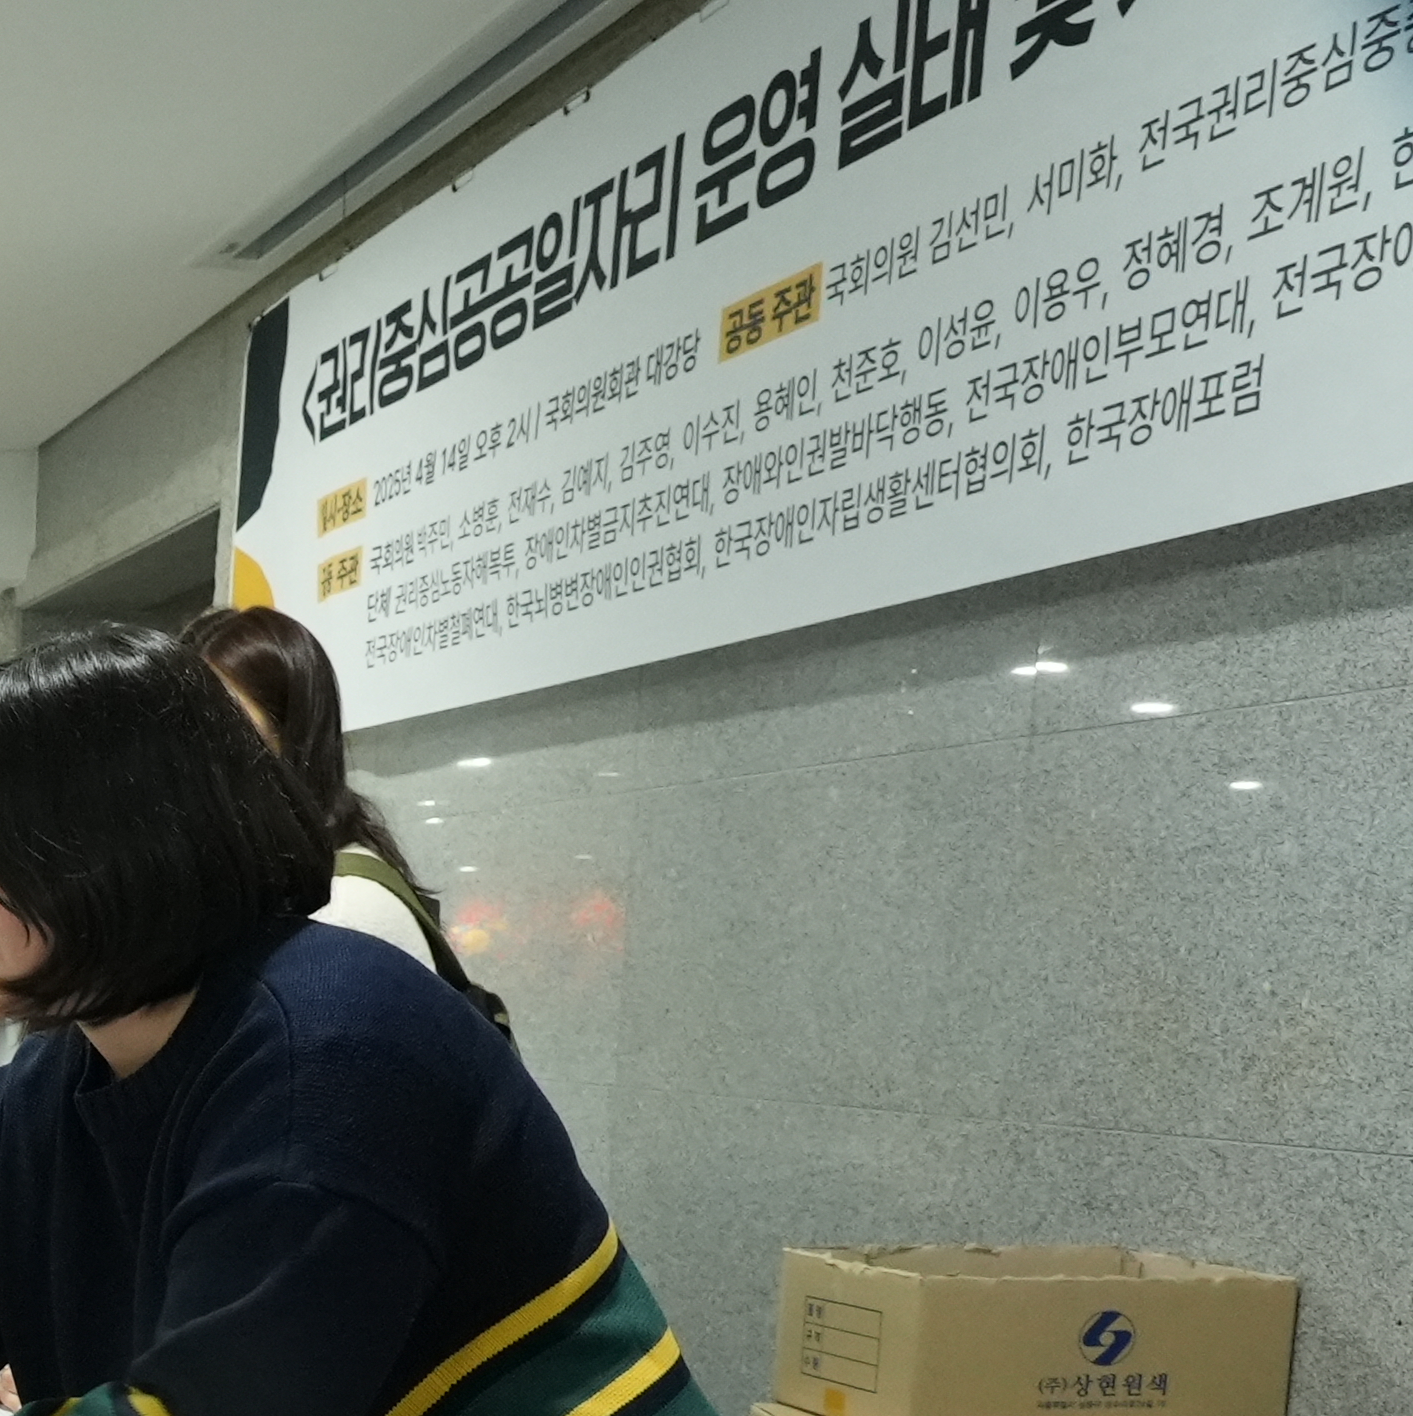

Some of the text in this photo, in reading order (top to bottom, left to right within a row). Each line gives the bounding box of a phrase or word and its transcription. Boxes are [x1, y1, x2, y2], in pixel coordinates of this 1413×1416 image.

[694, 46, 824, 247] 운영
[837, 0, 991, 172] 실태
[369, 530, 415, 575] 국회의원
[416, 514, 455, 556] 박주민,
[457, 495, 502, 541] 소병훈,
[560, 452, 613, 505] 김예지,
[619, 426, 675, 484] 김주영,
[682, 399, 745, 457] 이수진,
[753, 367, 823, 435] 용혜인,
[830, 337, 906, 404] 천준호,
[917, 298, 1001, 367] 이성윤,
[1014, 256, 1109, 329] 이용우,
[1122, 202, 1233, 291] 정혜경,
[1246, 145, 1371, 243] 조계원,
[724, 298, 766, 355] 공동
[770, 272, 817, 333] 주관
[825, 226, 920, 306] 국회의원
[929, 184, 1013, 265] 김선민,
[1026, 134, 1123, 216] 서미화,
[366, 588, 391, 624] 단체
[524, 470, 714, 572] 장애인차별금지추진연대,
[721, 386, 954, 506] 장애와인권발바닥행동,
[966, 275, 1255, 424] 전국장애인부모연대,
[372, 460, 413, 508] 2025년
[415, 444, 437, 487] 4월
[440, 433, 471, 476] 14일
[473, 421, 503, 463] 오후
[506, 408, 531, 450] 2시
[544, 361, 642, 430] 국회의원회관
[646, 328, 701, 387] 대강당
[713, 424, 1052, 570] 한국장애인자립생활센터협의회,
[1066, 352, 1265, 466] 한국장애포럼
